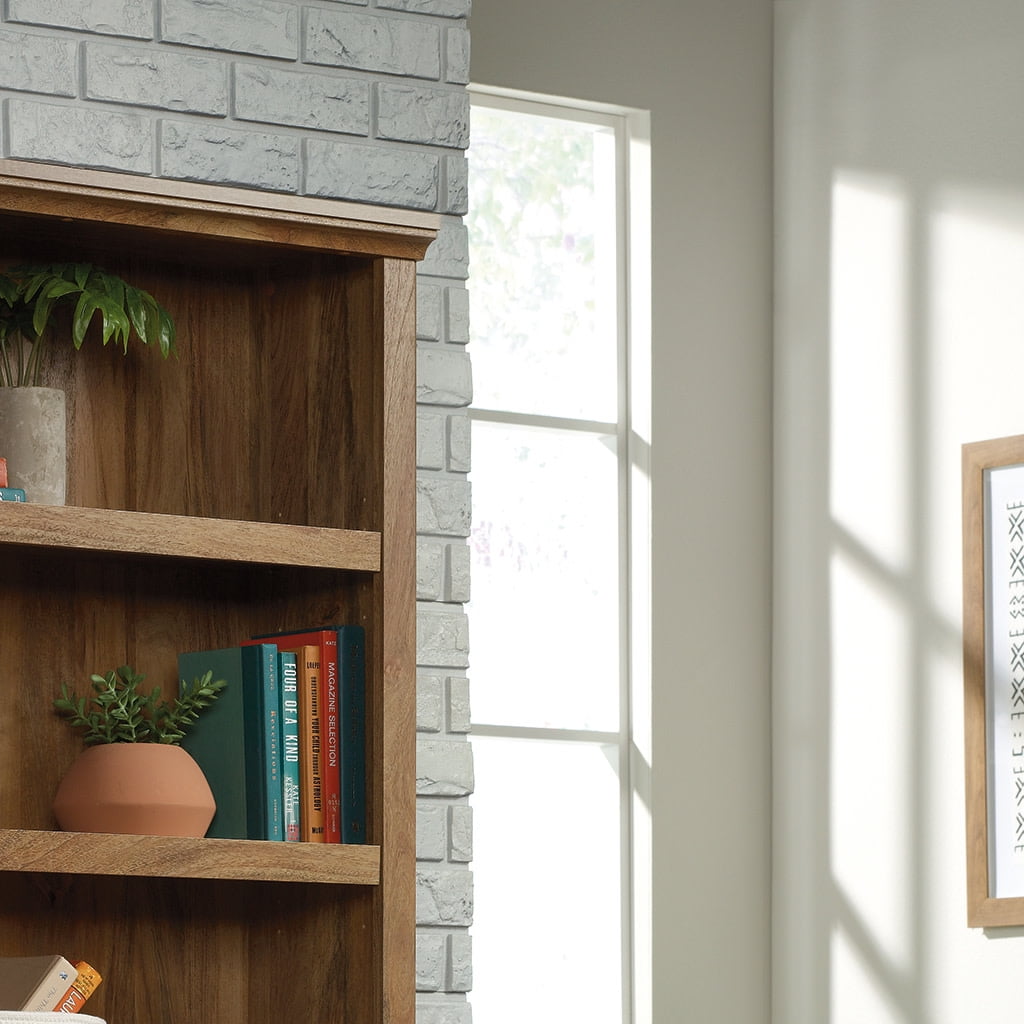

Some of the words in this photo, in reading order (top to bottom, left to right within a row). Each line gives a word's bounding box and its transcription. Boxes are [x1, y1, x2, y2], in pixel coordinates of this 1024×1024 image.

[284, 663, 297, 692] FOUR
[328, 662, 336, 713] MAGAZINE
[284, 700, 298, 712] OF
[284, 717, 297, 725] A
[311, 718, 320, 734] YOUR
[285, 734, 299, 762] KIND
[311, 735, 320, 753] CHILD
[328, 715, 337, 767] SELECTION
[313, 776, 322, 812] ASTROLOGY
